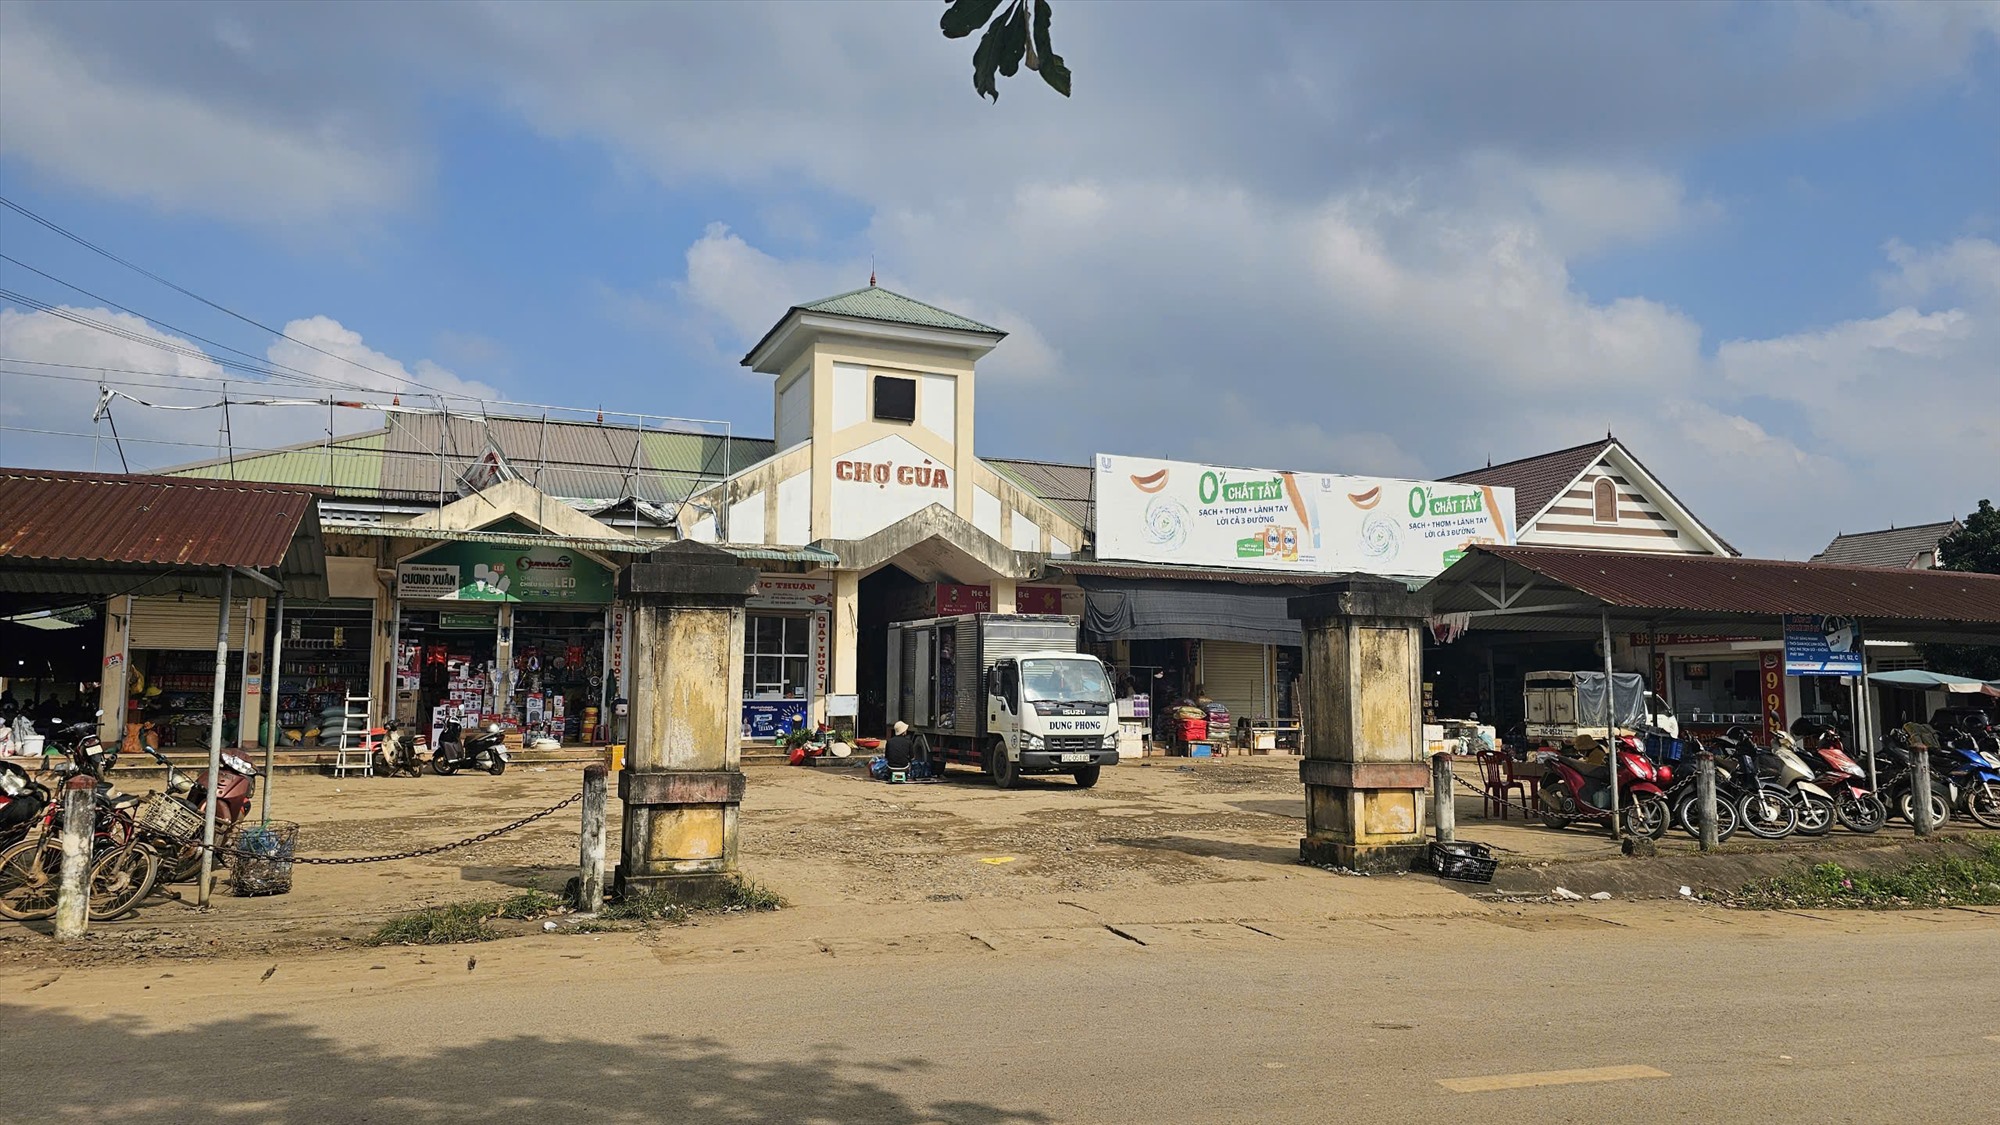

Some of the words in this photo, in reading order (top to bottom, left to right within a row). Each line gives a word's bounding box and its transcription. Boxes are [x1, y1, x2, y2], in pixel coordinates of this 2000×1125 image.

[836, 460, 893, 489] CHỢ
[897, 458, 949, 489] CÙA
[1228, 482, 1254, 499] CHẤT
[1434, 496, 1457, 513] CHẤT
[1198, 508, 1218, 517] SẠCH
[1225, 507, 1247, 515] THƠM
[1254, 505, 1274, 513] LÀNH
[1409, 522, 1426, 531] SẠCH
[1432, 520, 1451, 528] THƠM
[432, 573, 456, 586] XUÂN
[554, 577, 576, 588] LED
[775, 582, 816, 591] THUẬN
[1075, 721, 1101, 730] PHONG
